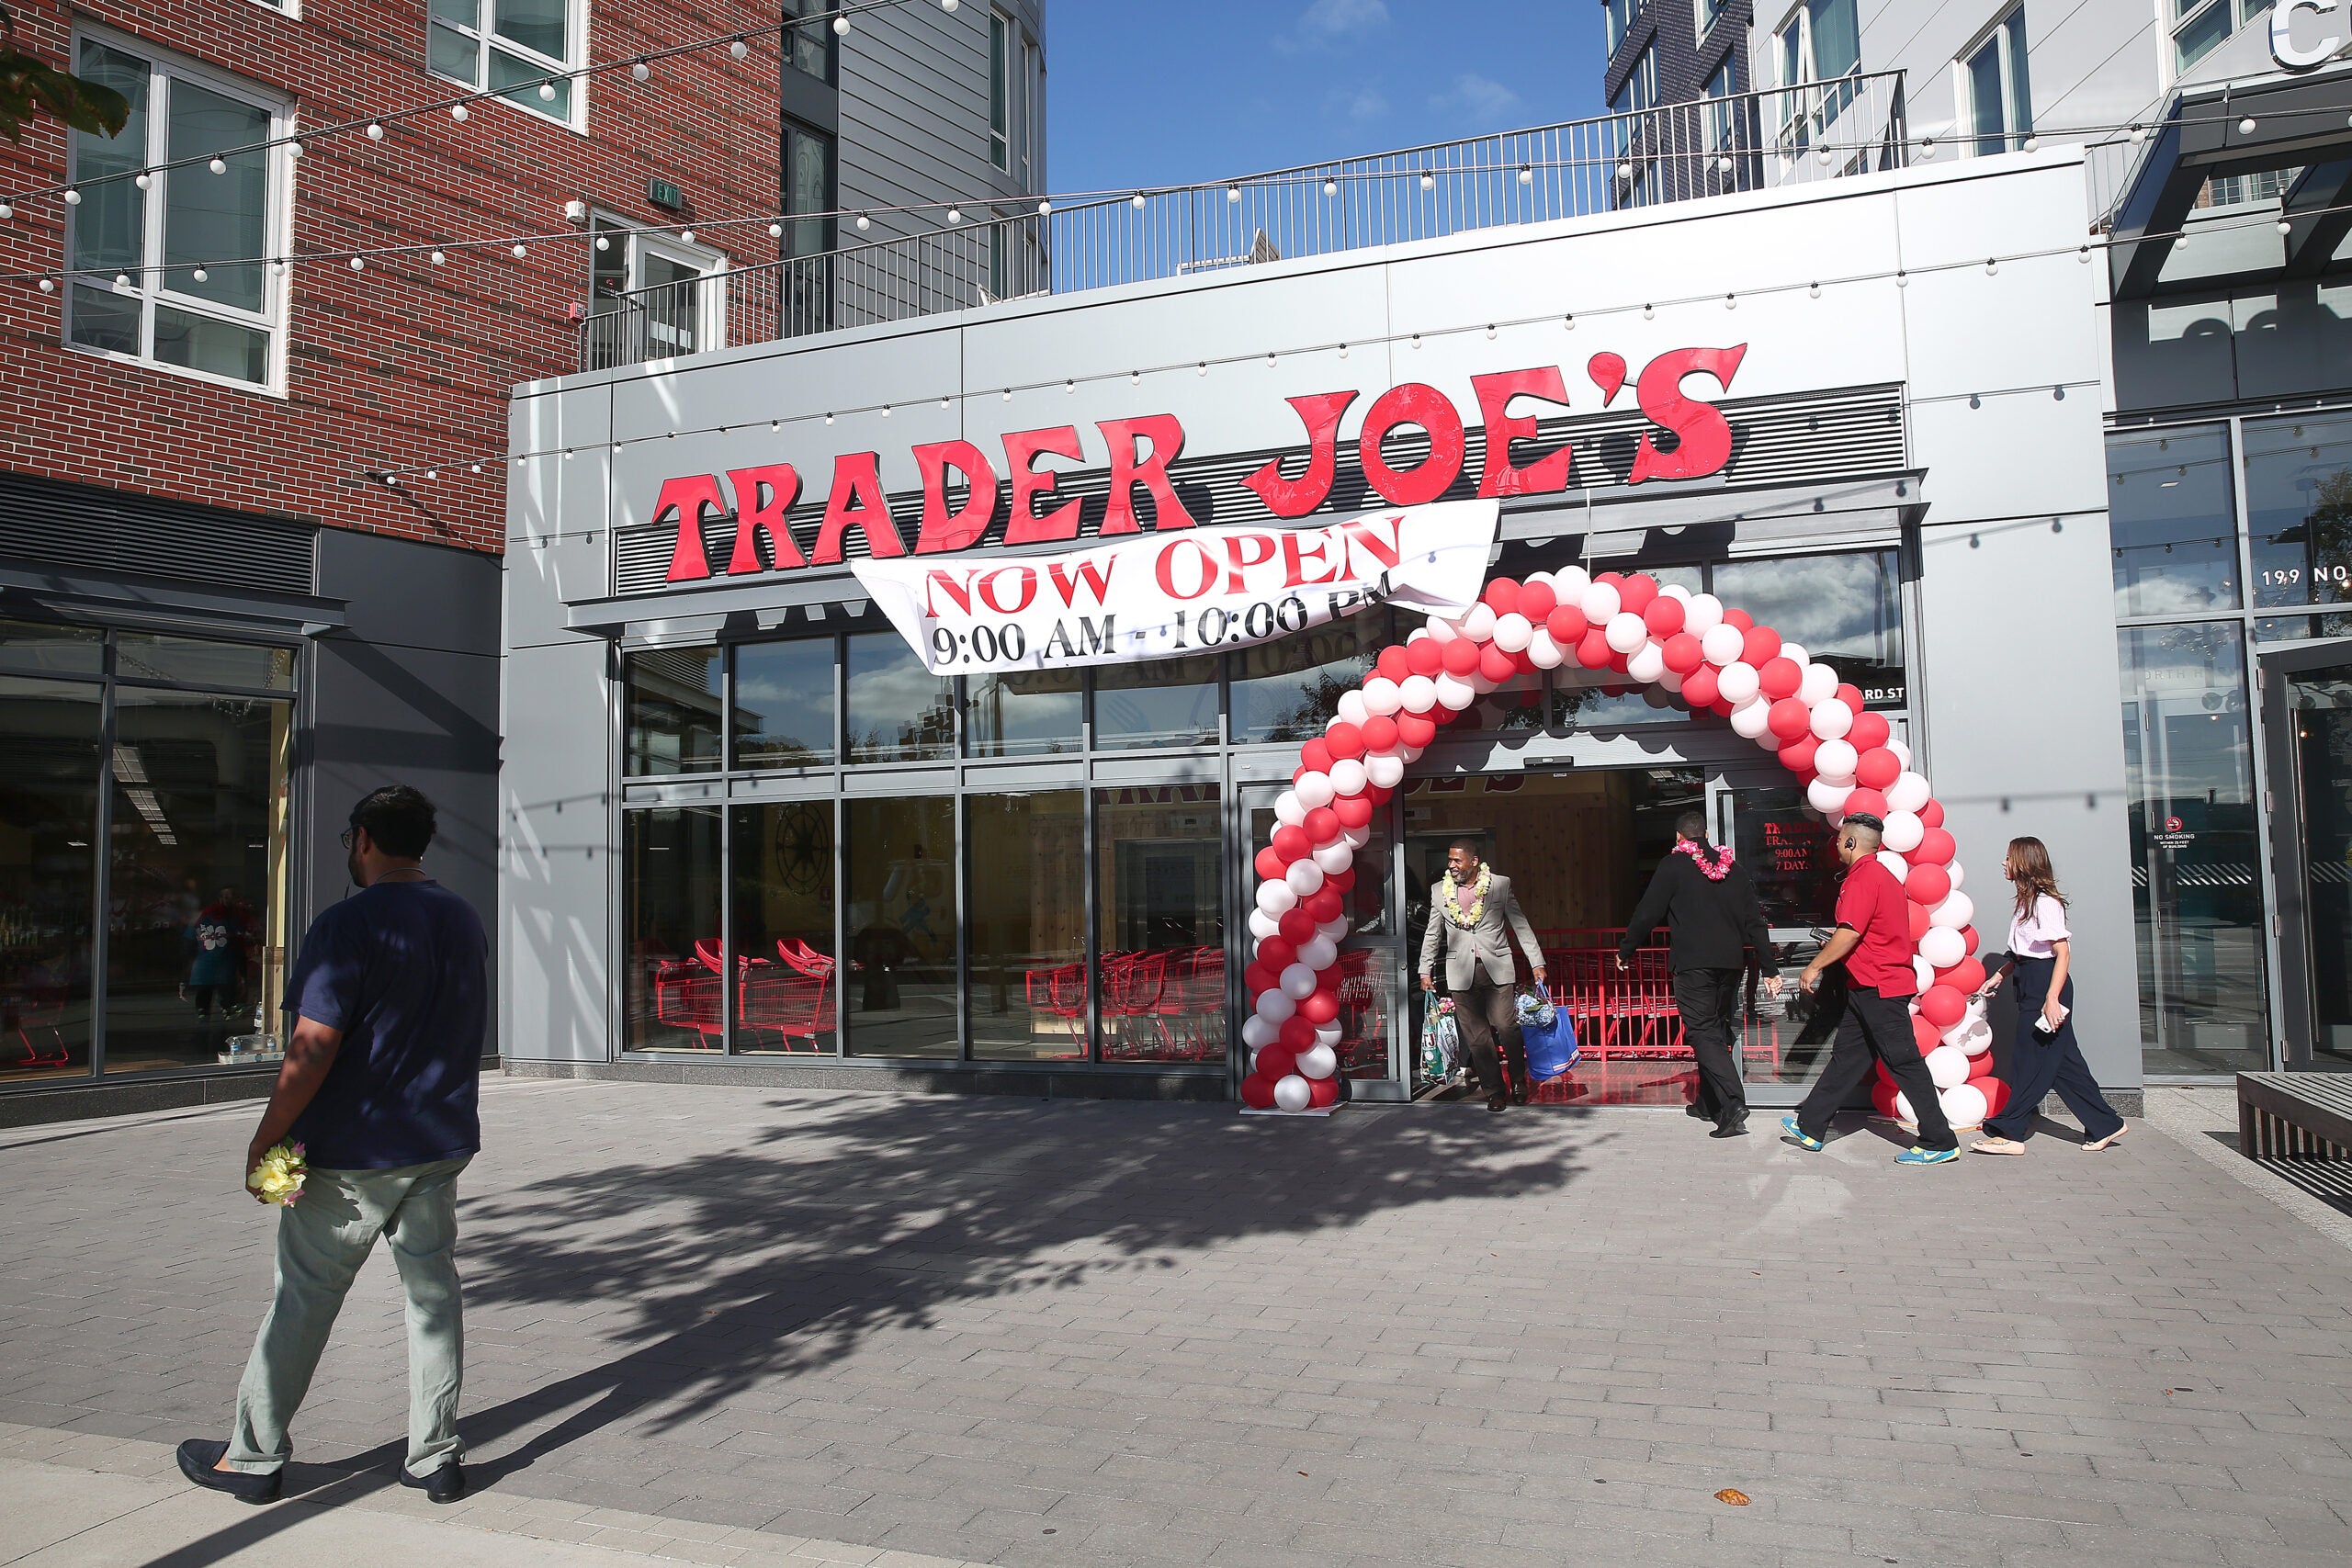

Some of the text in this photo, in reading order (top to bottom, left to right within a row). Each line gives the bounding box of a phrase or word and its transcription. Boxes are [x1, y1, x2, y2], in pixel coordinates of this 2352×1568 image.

[656, 182, 678, 205] EXIT
[650, 342, 1748, 582] TRADER JOE'S
[925, 514, 1407, 617] NOW OPEN
[2262, 565, 2347, 586] 199 NO
[932, 623, 1026, 666] 9:00
[1043, 614, 1117, 659] AM
[1172, 596, 1309, 649] 10:00
[1887, 687, 1905, 699] ST
[1776, 861, 1781, 871] 7
